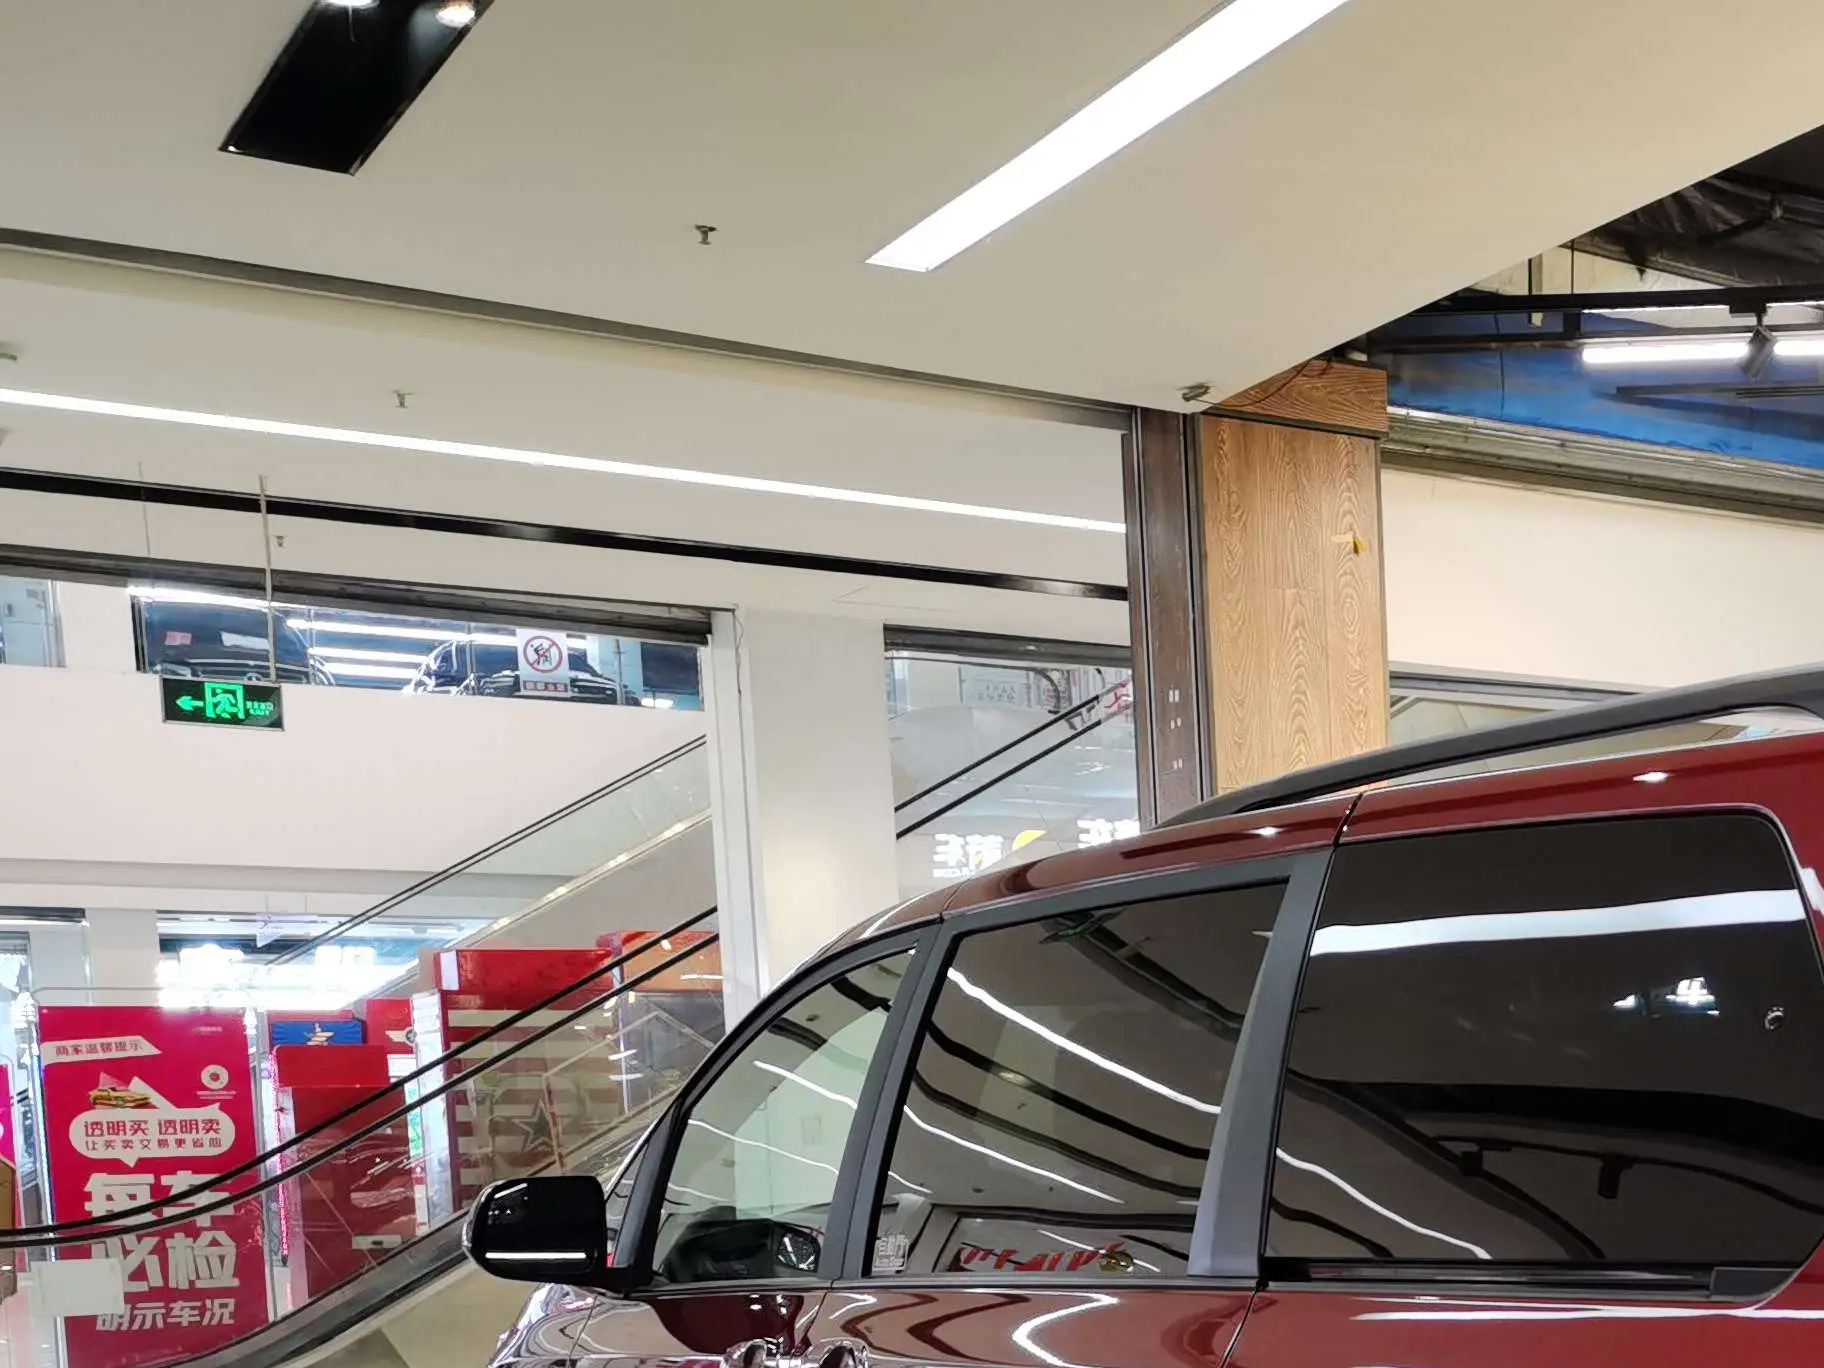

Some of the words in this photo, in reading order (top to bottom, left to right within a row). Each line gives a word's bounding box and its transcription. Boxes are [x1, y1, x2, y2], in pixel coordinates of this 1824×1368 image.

[84, 1120, 149, 1137] 透明买
[158, 1119, 221, 1135] 透明卖
